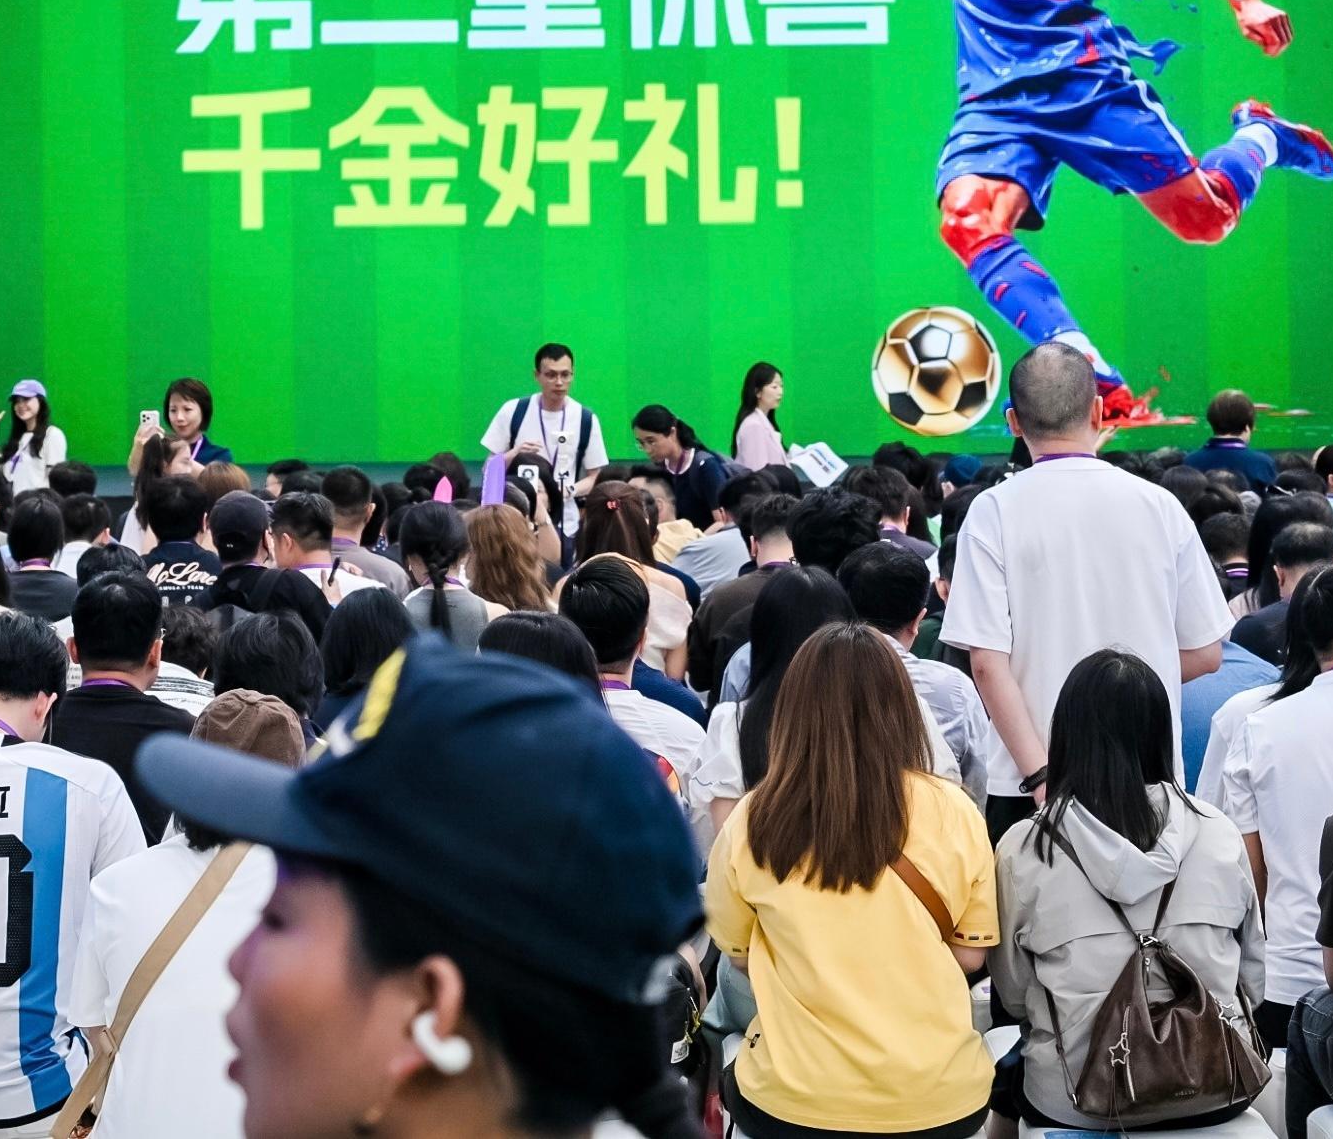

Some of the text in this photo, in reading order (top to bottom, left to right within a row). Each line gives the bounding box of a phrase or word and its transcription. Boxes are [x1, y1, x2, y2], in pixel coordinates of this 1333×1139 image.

[181, 83, 804, 230] 千金好礼!
[147, 562, 218, 586] McLare
